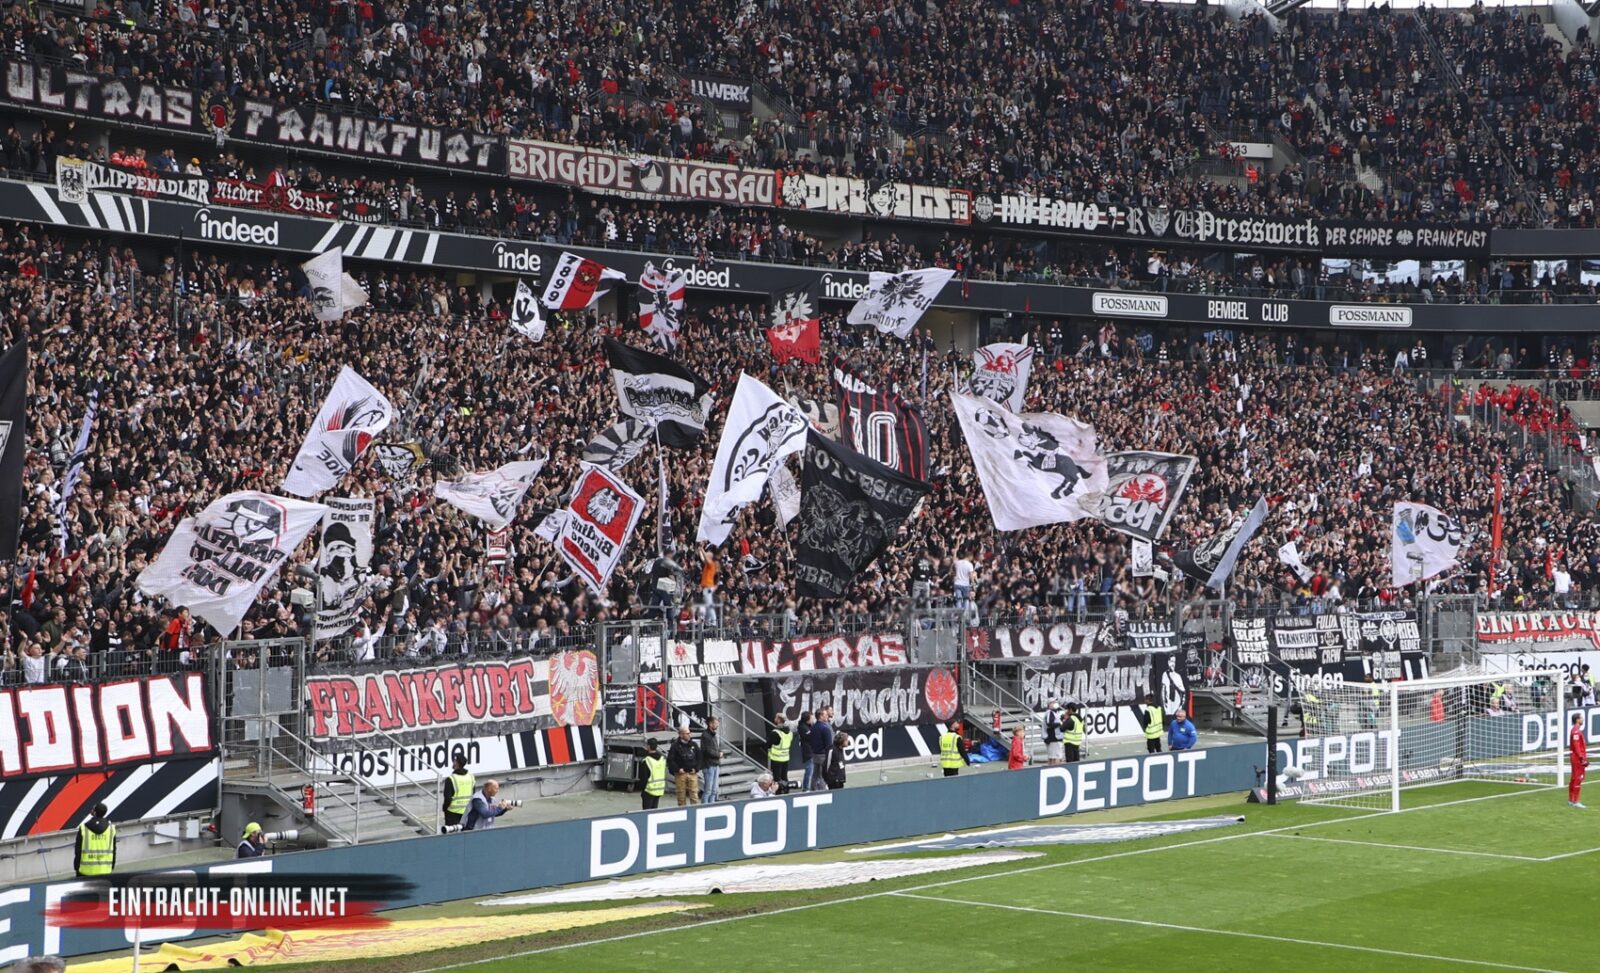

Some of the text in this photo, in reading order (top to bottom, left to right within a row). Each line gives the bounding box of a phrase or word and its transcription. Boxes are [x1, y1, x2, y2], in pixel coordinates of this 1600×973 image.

[6, 61, 499, 167] ULTRAS FRANKFURT
[87, 163, 210, 204] KLIPPENADLER
[508, 143, 633, 189] BRIGADE
[669, 165, 774, 204] NASSAU
[201, 212, 279, 246] indeed
[1000, 195, 1099, 231] INFERNO
[1325, 227, 1488, 247] PER SEMPRE FRANKFURT
[497, 246, 541, 272] inde
[1100, 297, 1161, 312] POSSMANN
[1208, 300, 1289, 322] BEMBEL CLUB
[1338, 310, 1404, 322] POSSMANN
[1129, 622, 1172, 633] ULTRAS
[1278, 632, 1318, 645] FRANKFURT
[1315, 614, 1339, 630] FULDA
[740, 634, 910, 675] ULTRAS
[995, 622, 1102, 659] 1997
[1134, 637, 1171, 648] NEVER
[1321, 649, 1342, 665] CREW
[671, 664, 697, 679] NOVA
[698, 661, 738, 677] GUARDIA
[305, 658, 536, 738] FRANKFURT
[777, 671, 925, 735] Eintracht
[1085, 711, 1119, 736] eed
[399, 739, 481, 773] finden
[845, 727, 884, 760] eed
[1266, 729, 1401, 784] DEPOT
[1039, 750, 1207, 816] DEPOT
[591, 793, 833, 878] DEPOT
